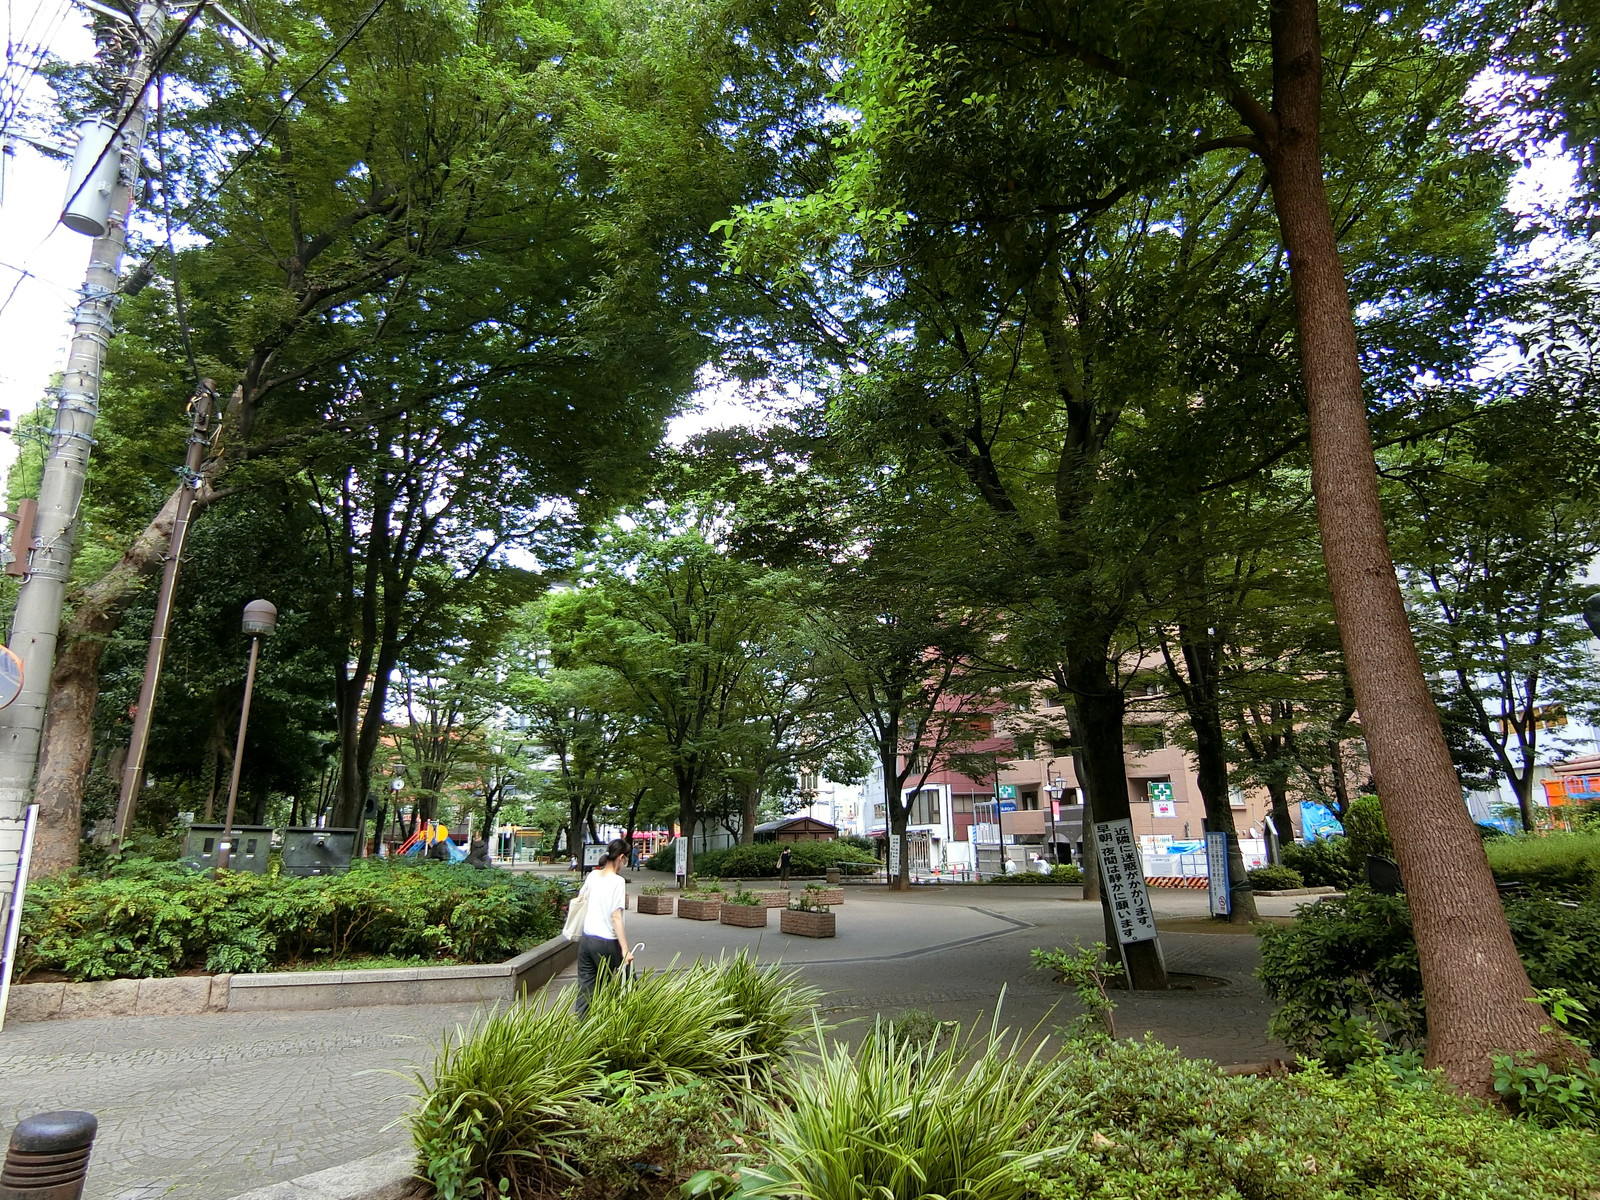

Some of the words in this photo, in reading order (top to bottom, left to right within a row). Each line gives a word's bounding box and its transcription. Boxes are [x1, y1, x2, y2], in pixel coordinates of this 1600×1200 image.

[1097, 824, 1137, 940] 早朝・夜間は静かに願います。
[1114, 826, 1152, 928] 近隣に迷惑がかかります。
